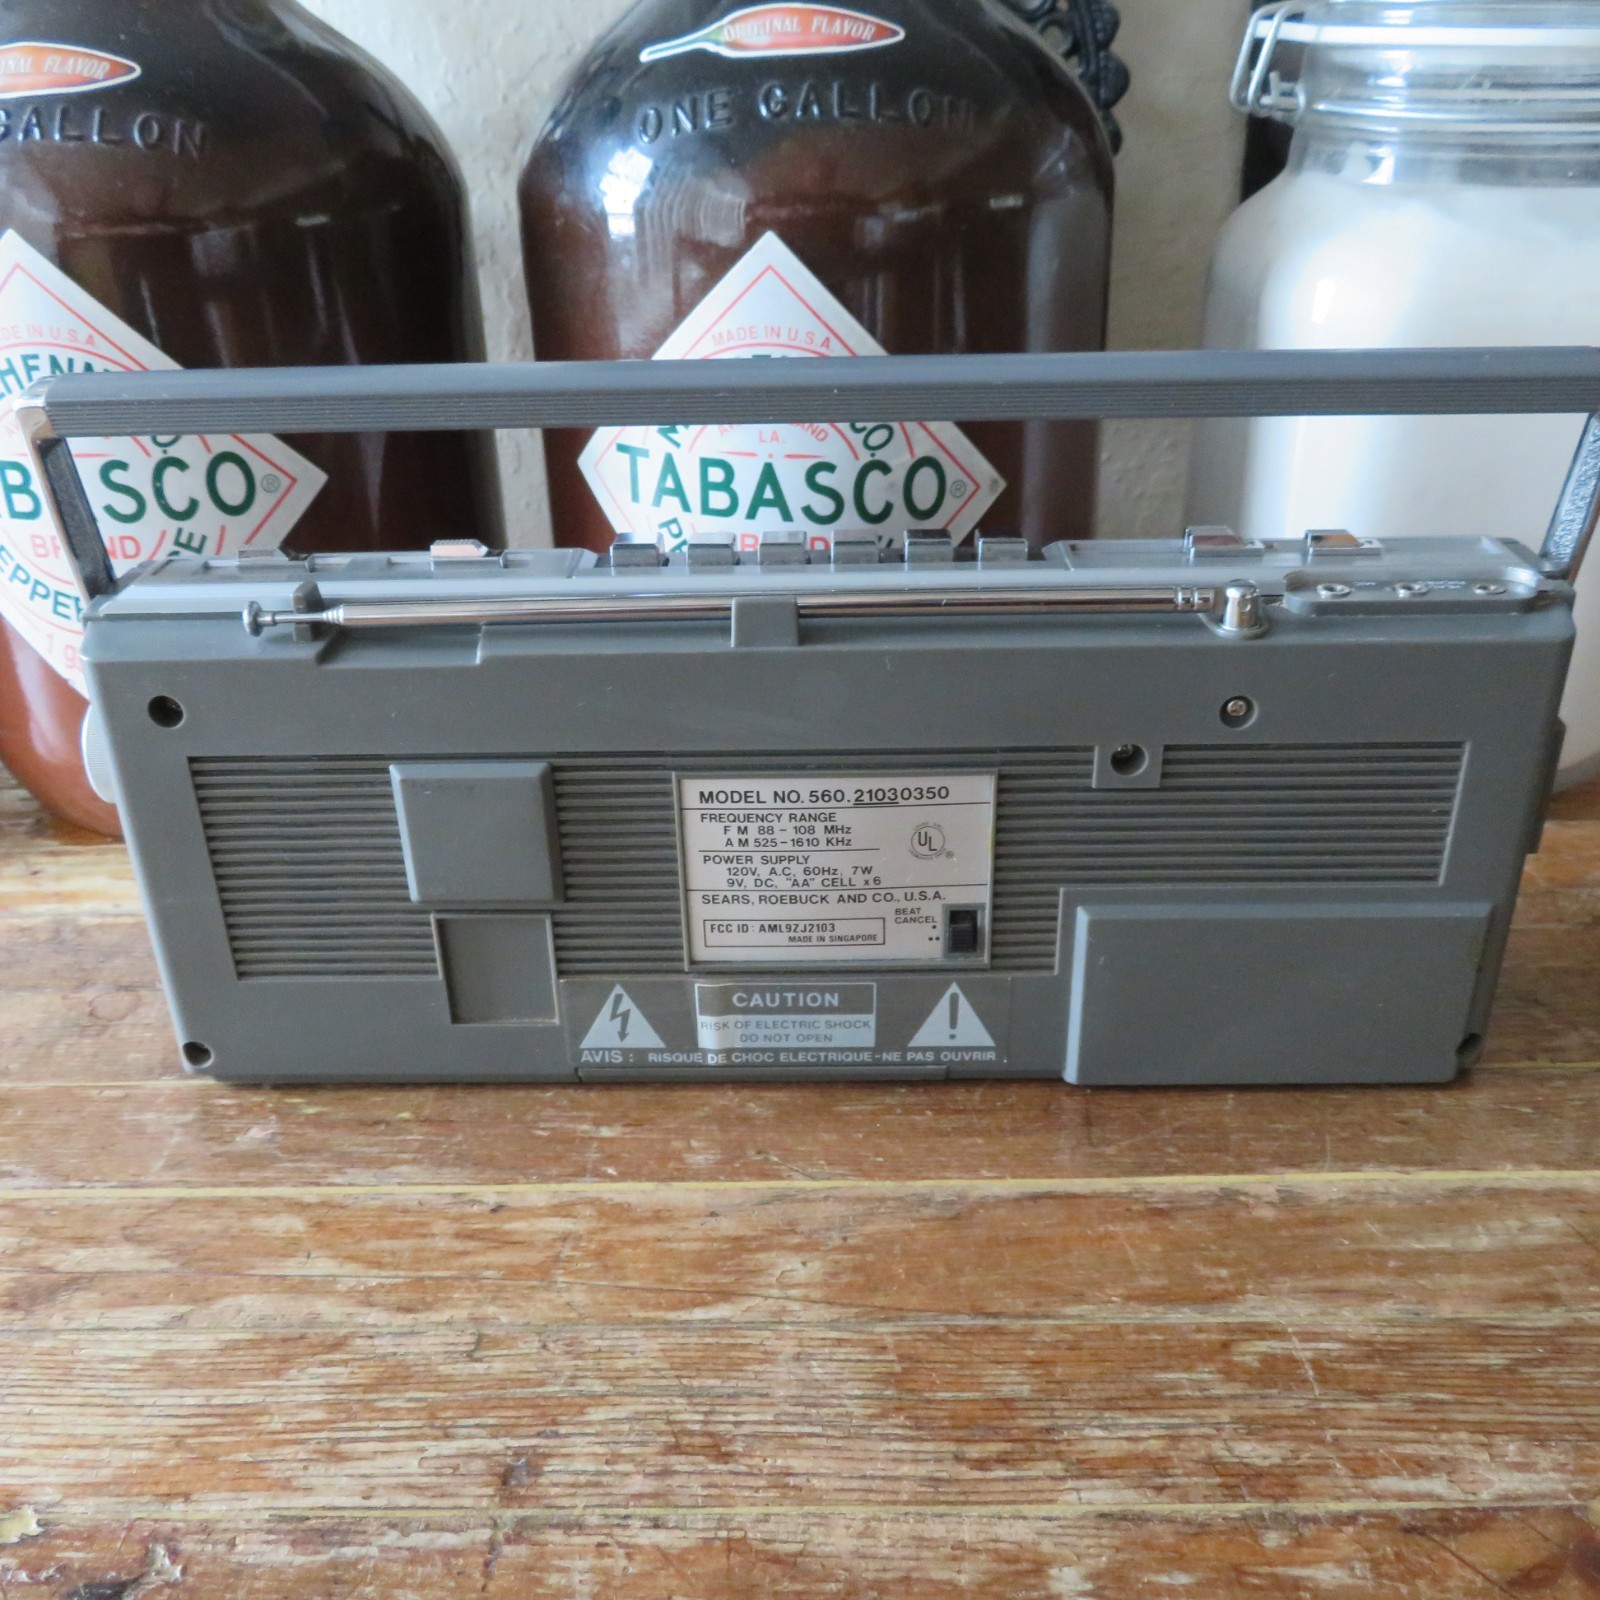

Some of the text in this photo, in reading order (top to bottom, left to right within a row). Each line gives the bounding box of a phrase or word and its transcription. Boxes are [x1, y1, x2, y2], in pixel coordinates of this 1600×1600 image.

[724, 16, 877, 41] ORIGINAL FLAVOR
[43, 55, 110, 80] FLAVOR
[638, 79, 976, 144] ONE GALLON
[711, 326, 758, 347] MADE
[764, 325, 781, 339] IN
[759, 430, 786, 444] LA.
[616, 443, 947, 526] TABASCO
[699, 790, 767, 804] MODEL
[773, 789, 804, 804] NO.
[700, 812, 837, 823] FREQUENCY RANGE
[823, 825, 852, 834] MHz
[826, 837, 852, 846] KHz
[917, 831, 938, 851] UL
[703, 855, 811, 864] POWER SUPPLY
[851, 865, 873, 875] 7W
[821, 877, 856, 887] CELL
[701, 894, 755, 906] SEARS,
[758, 894, 830, 905] ROEBUCK
[837, 893, 867, 904] AND
[904, 890, 946, 901] U.S.A.
[895, 907, 938, 924] BEAT CANCEL
[710, 923, 733, 933] FCC
[788, 934, 878, 943] MADE IN SINGAPORE
[732, 992, 839, 1007] CAUTION
[700, 1020, 872, 1031] RISK OF ELECTRIC SHOCK
[739, 1033, 833, 1043] DO NOT OPEN
[648, 1053, 702, 1063] RISQUE
[707, 1053, 728, 1064] DE
[731, 1052, 774, 1063] CHOC
[906, 1051, 935, 1061] PAS
[940, 1051, 997, 1061] OUVRIR
